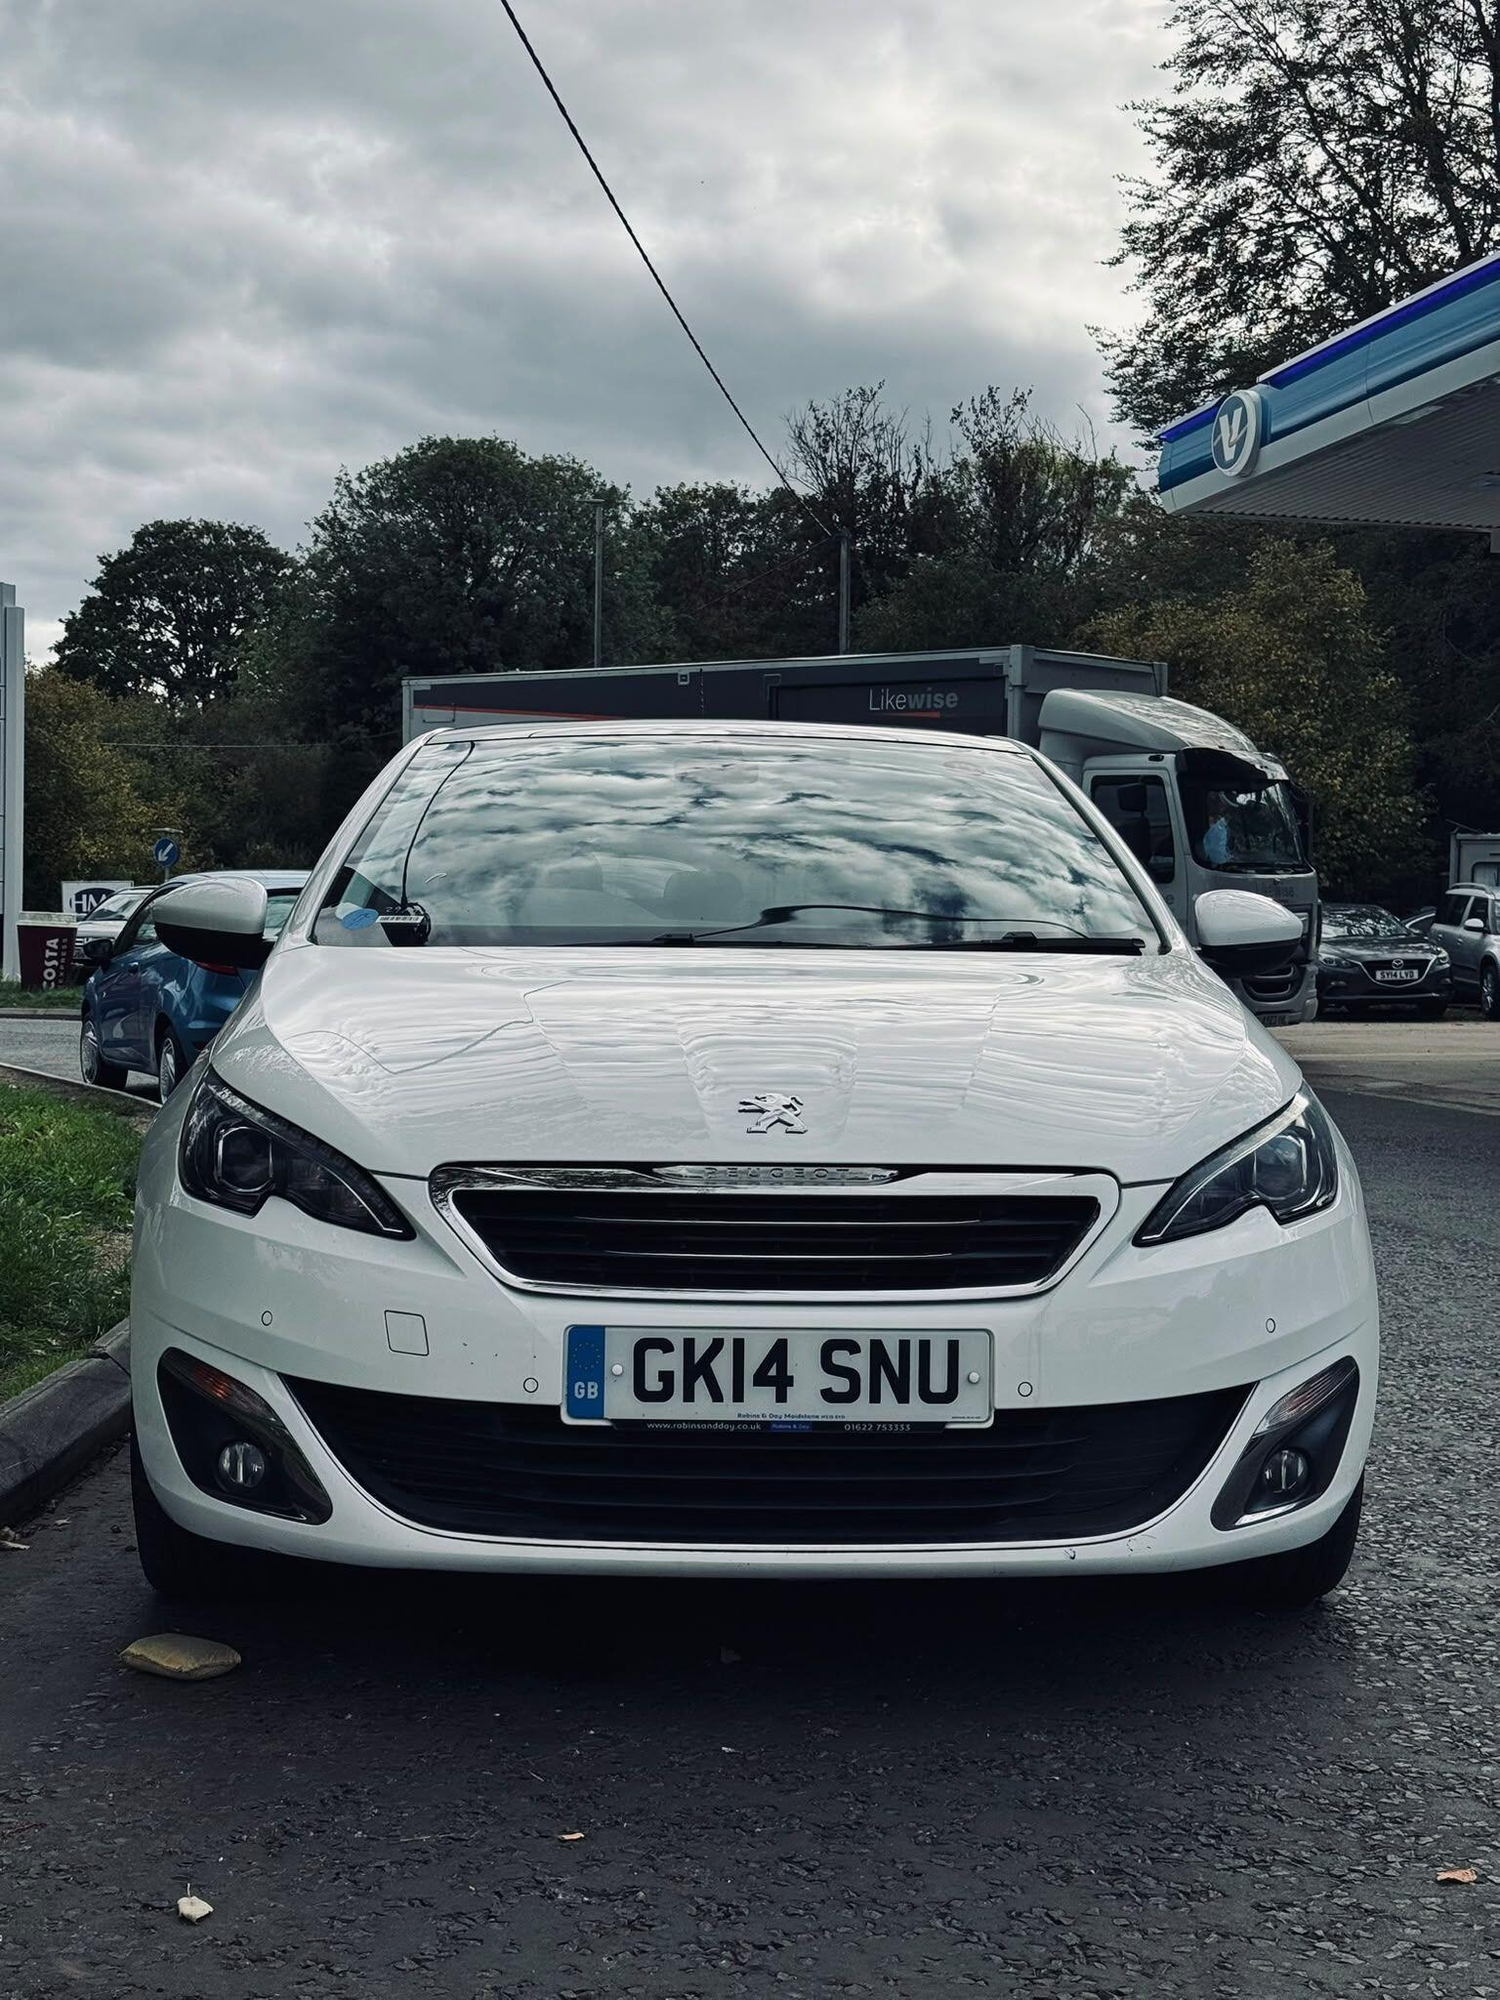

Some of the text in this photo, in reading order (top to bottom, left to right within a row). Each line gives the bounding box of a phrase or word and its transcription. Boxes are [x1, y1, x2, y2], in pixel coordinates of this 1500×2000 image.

[868, 687, 959, 711] Likewise
[42, 938, 59, 990] COSTA
[703, 1166, 850, 1180] PEUGEOT
[632, 1336, 960, 1405] GK14 SNU
[573, 1381, 599, 1400] GB
[646, 1421, 762, 1432] www.robinsandday.co.uk
[844, 1423, 912, 1431] 01622 753333
